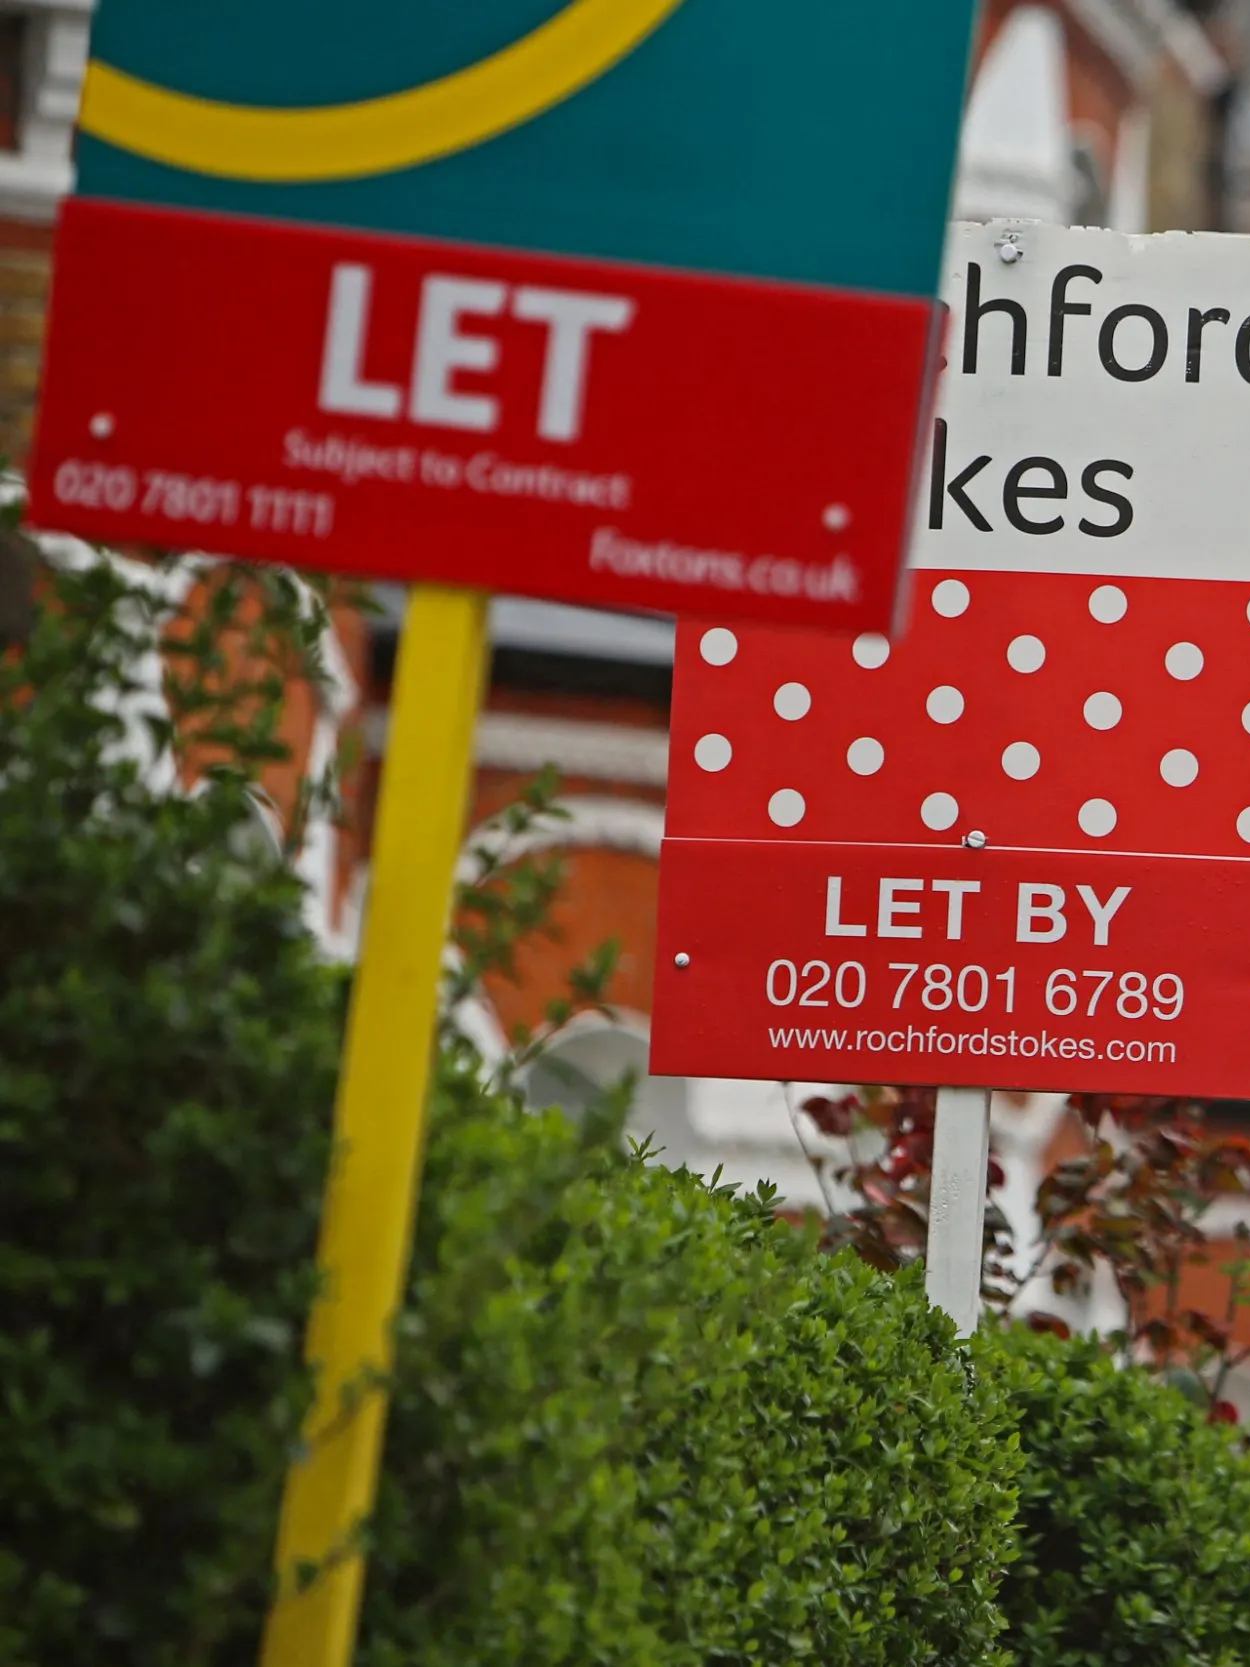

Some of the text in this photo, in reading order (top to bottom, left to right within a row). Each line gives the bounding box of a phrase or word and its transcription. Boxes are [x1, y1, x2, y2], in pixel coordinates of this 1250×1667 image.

[317, 262, 636, 443] LET
[53, 459, 334, 538] 020 7801 1111
[283, 430, 630, 509] Subject to Contract
[928, 417, 1134, 538] kes
[588, 526, 859, 604] Foxtons.co.uk
[825, 876, 1132, 946] LET BY
[766, 958, 1185, 1021] 020 7801 6789
[768, 1024, 1176, 1064] www.rochfordstokes.com
